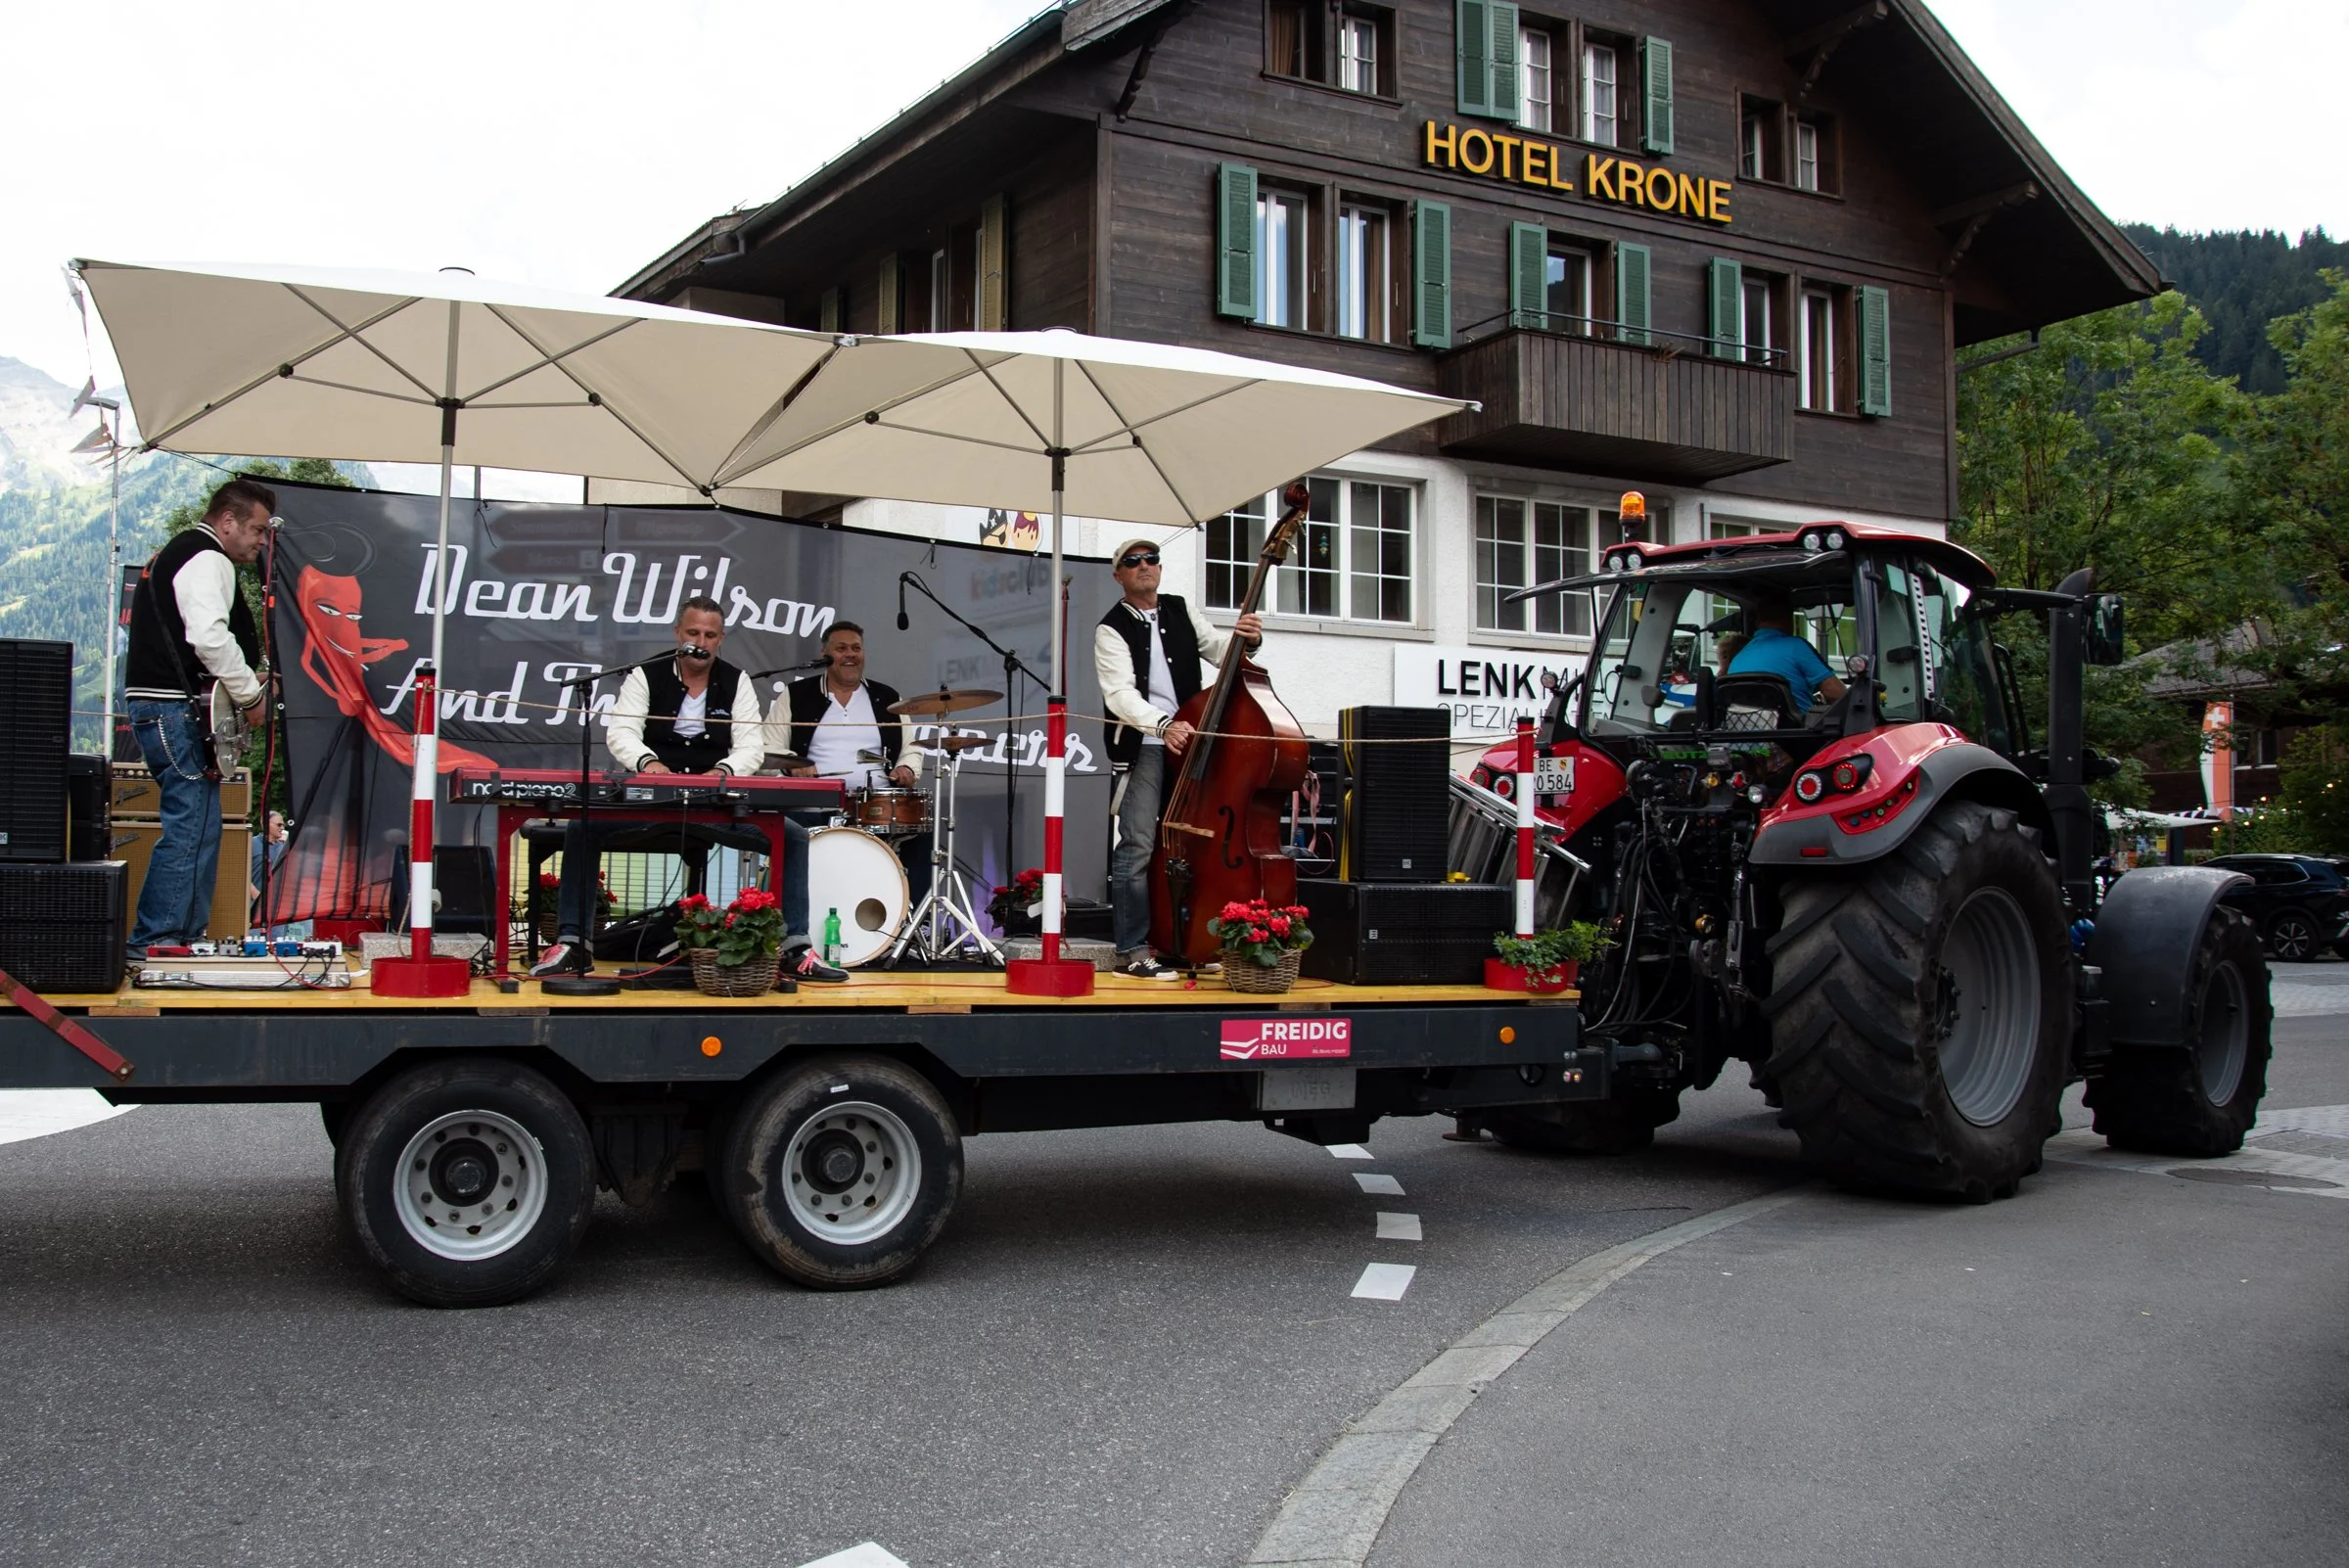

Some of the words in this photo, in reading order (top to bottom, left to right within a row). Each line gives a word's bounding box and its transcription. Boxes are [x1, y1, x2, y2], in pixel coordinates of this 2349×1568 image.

[1424, 120, 1573, 191] HOTEL
[1586, 154, 1731, 223] KRONE
[415, 543, 598, 622] Dean
[603, 552, 836, 638] Wilson
[380, 658, 530, 724] And
[543, 662, 619, 726] Th
[1539, 759, 1553, 772] BE
[1261, 1022, 1347, 1040] FREIDIG
[1261, 1044, 1287, 1055] BAU
